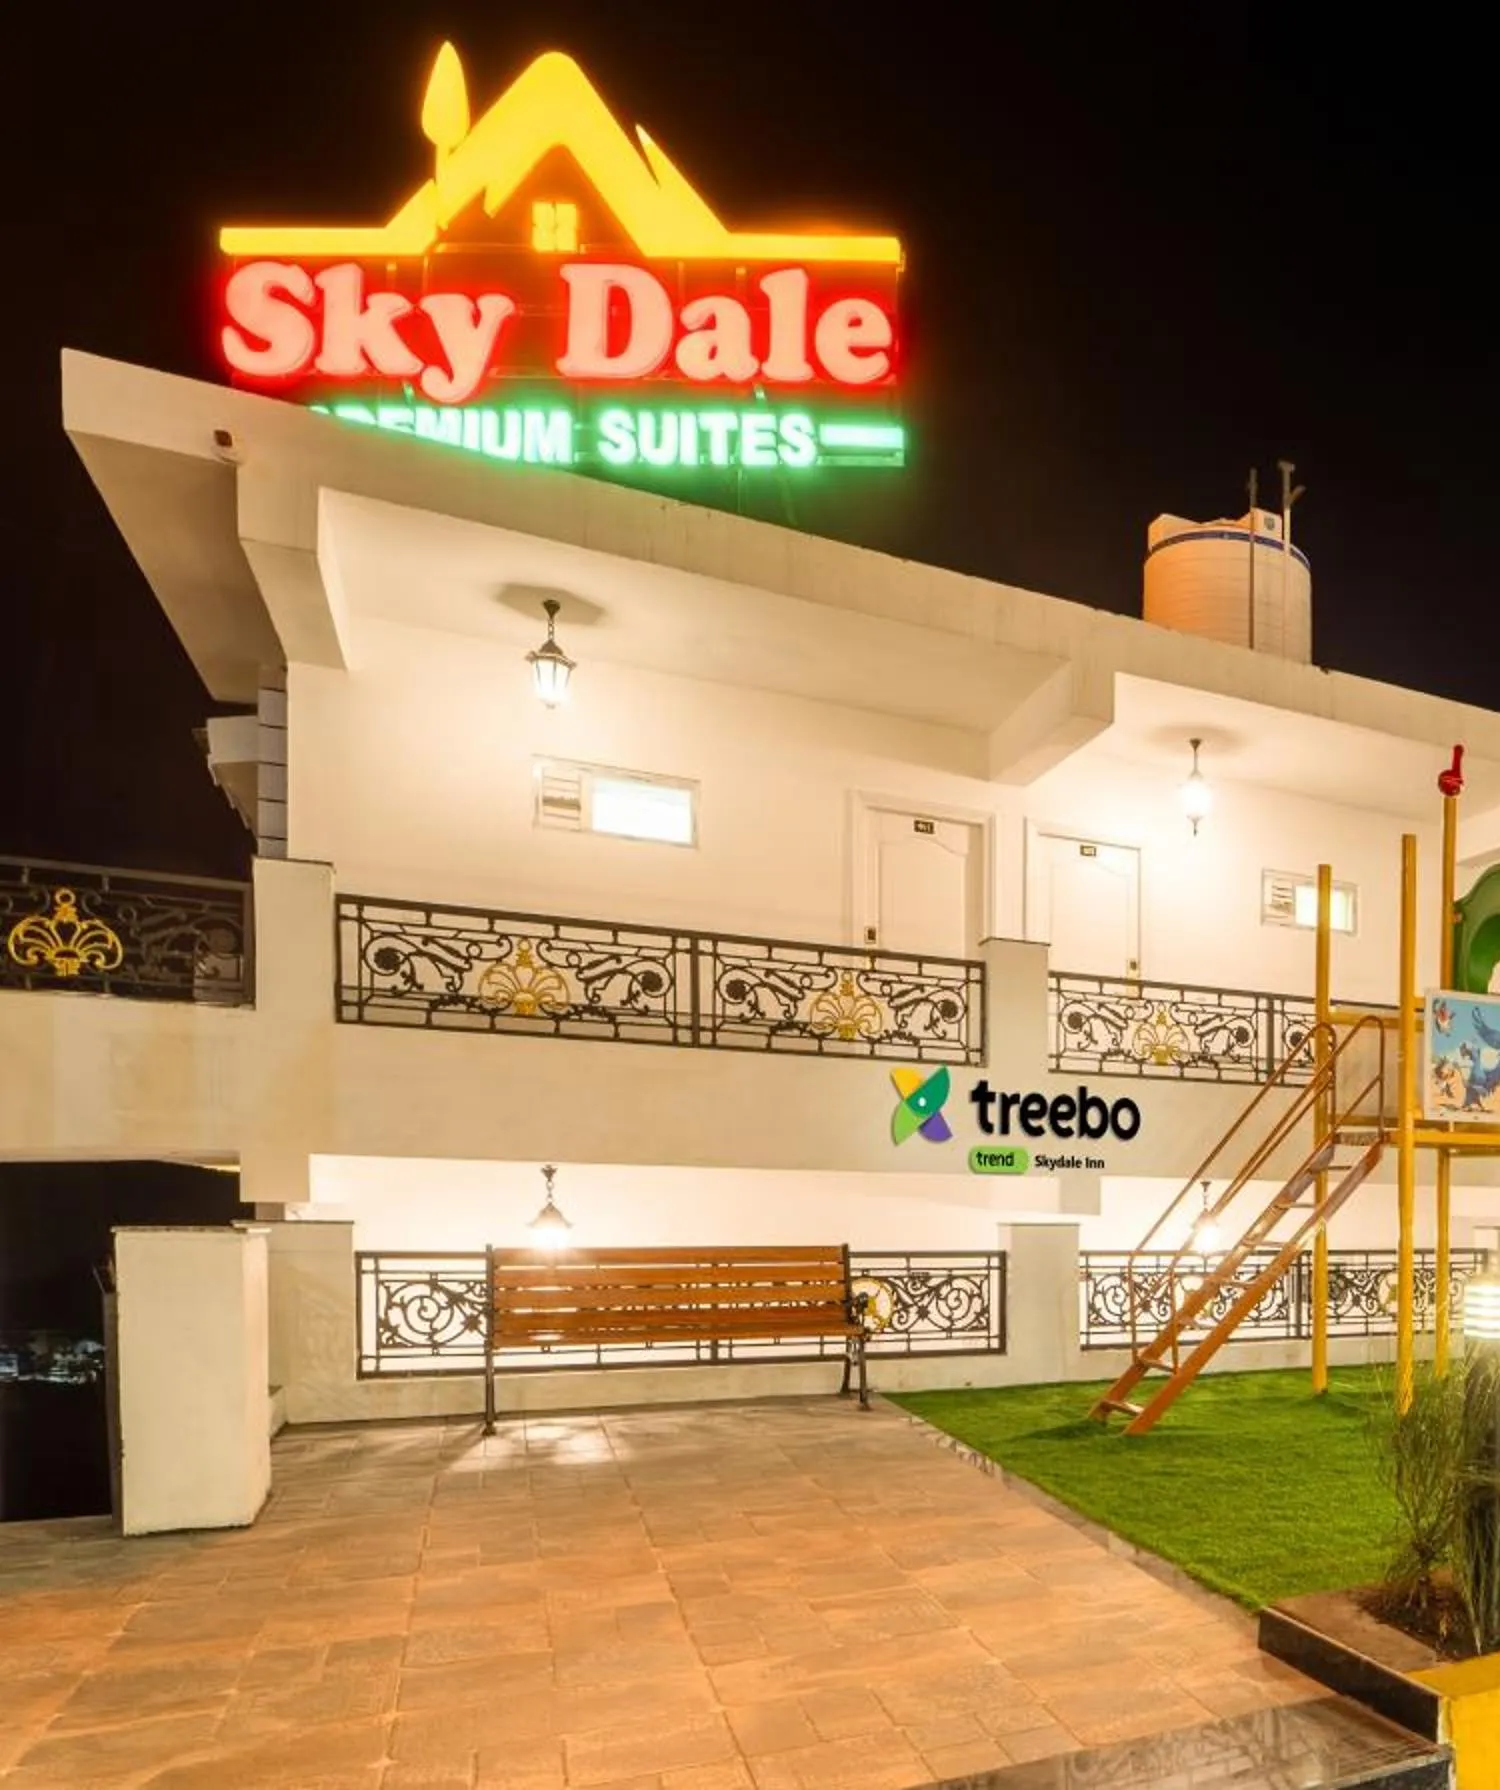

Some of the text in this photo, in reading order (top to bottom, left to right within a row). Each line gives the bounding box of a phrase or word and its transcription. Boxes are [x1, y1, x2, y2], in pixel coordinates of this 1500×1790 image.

[220, 262, 894, 403] Sky Dale
[308, 404, 819, 467] EMIUM SUITES
[970, 1079, 1141, 1141] treebo
[976, 1151, 1015, 1167] trend
[1034, 1154, 1105, 1170] Skydale Inn
